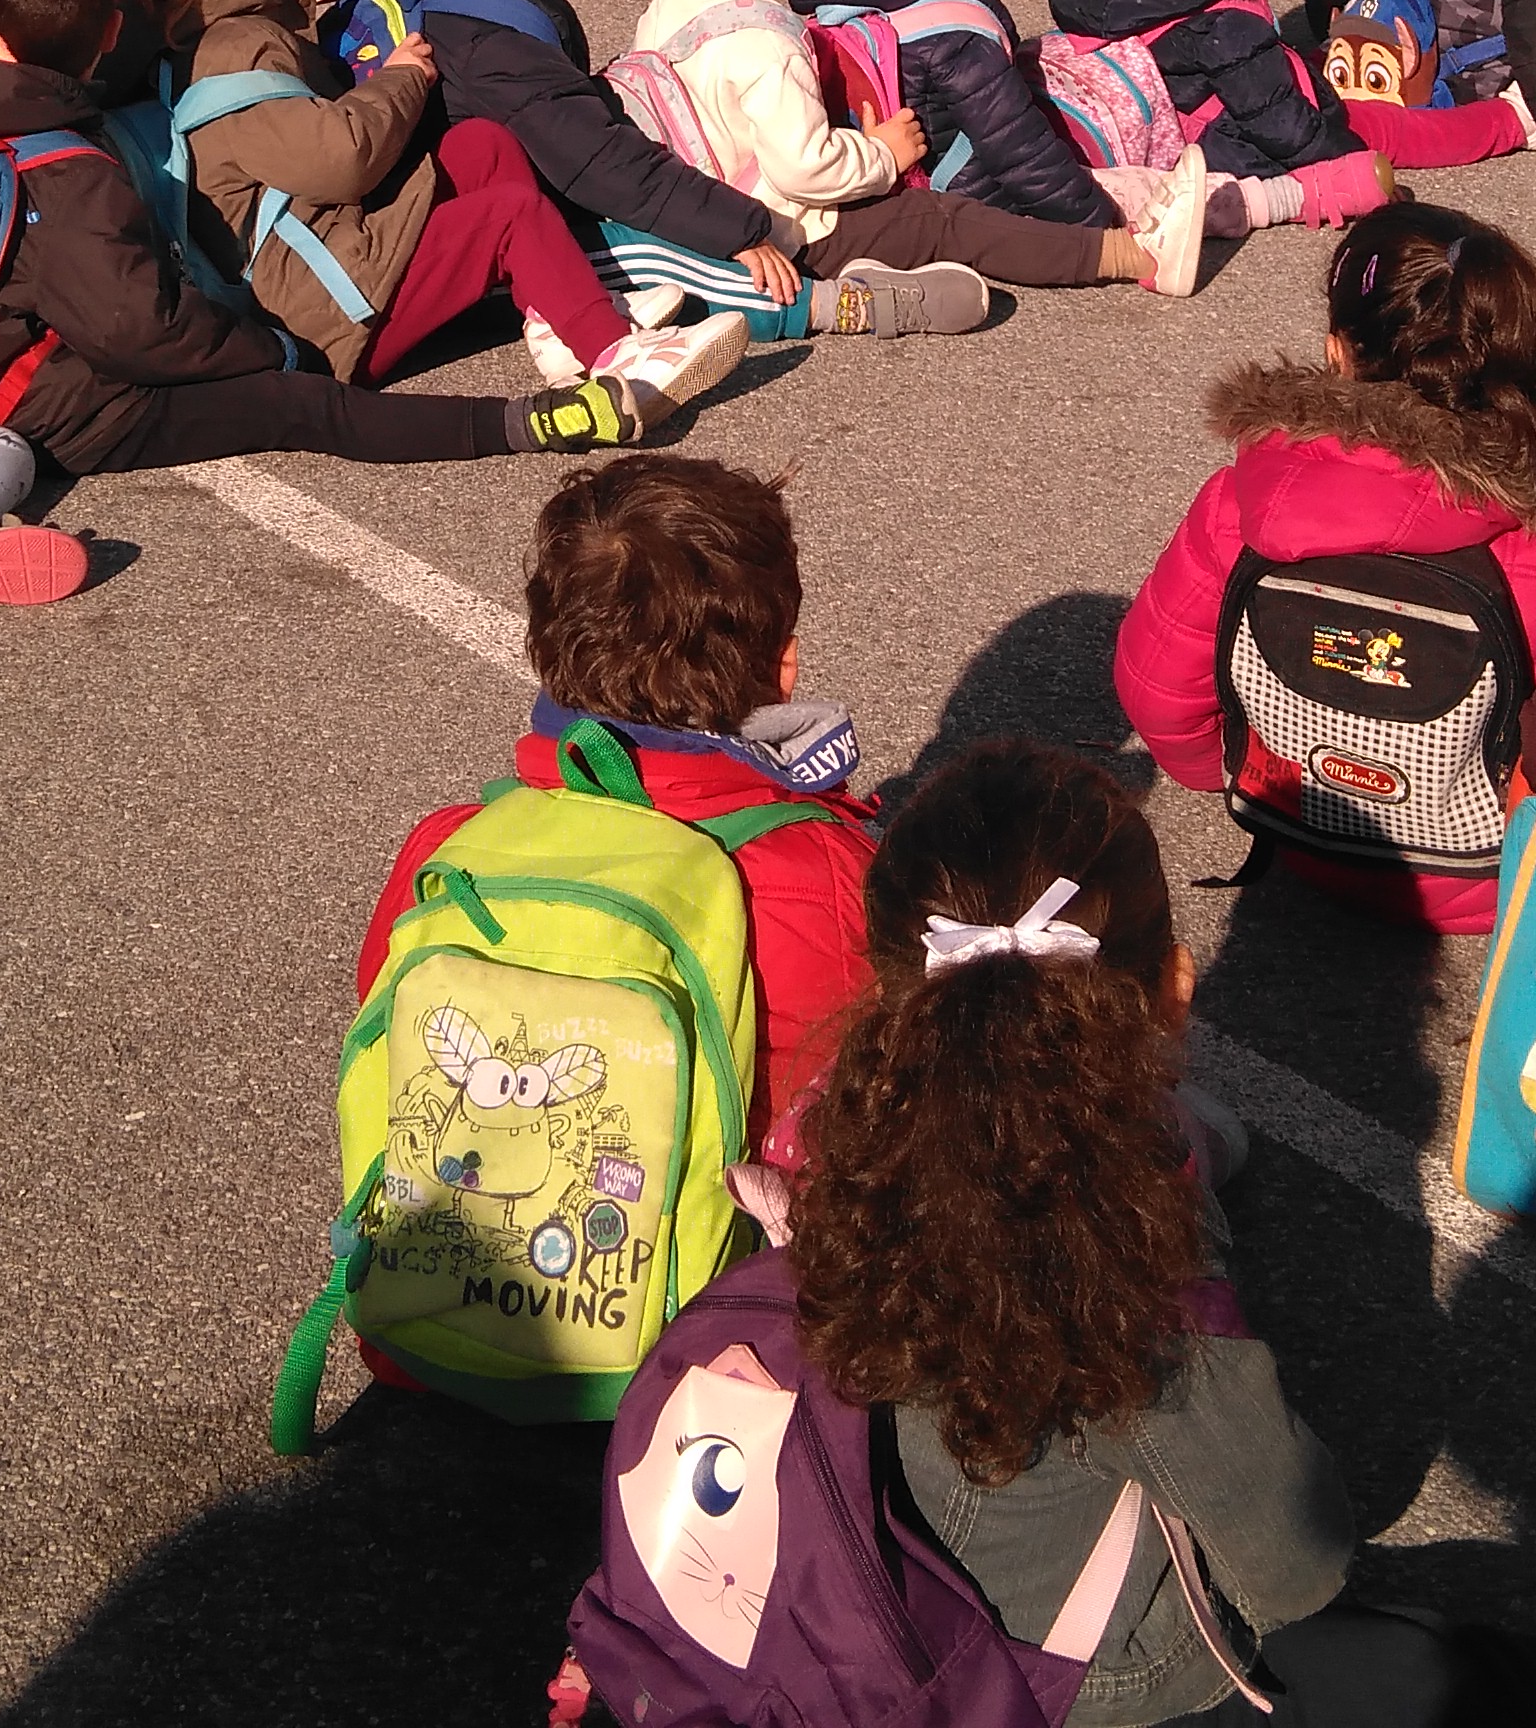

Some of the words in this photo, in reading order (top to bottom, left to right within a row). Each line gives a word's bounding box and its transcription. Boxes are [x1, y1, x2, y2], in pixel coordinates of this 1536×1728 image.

[1312, 655, 1351, 672] Minnie
[1324, 759, 1392, 791] Minnie
[602, 1157, 642, 1187] WRONG
[604, 1177, 628, 1197] WAY
[464, 1275, 629, 1331] MOVING
